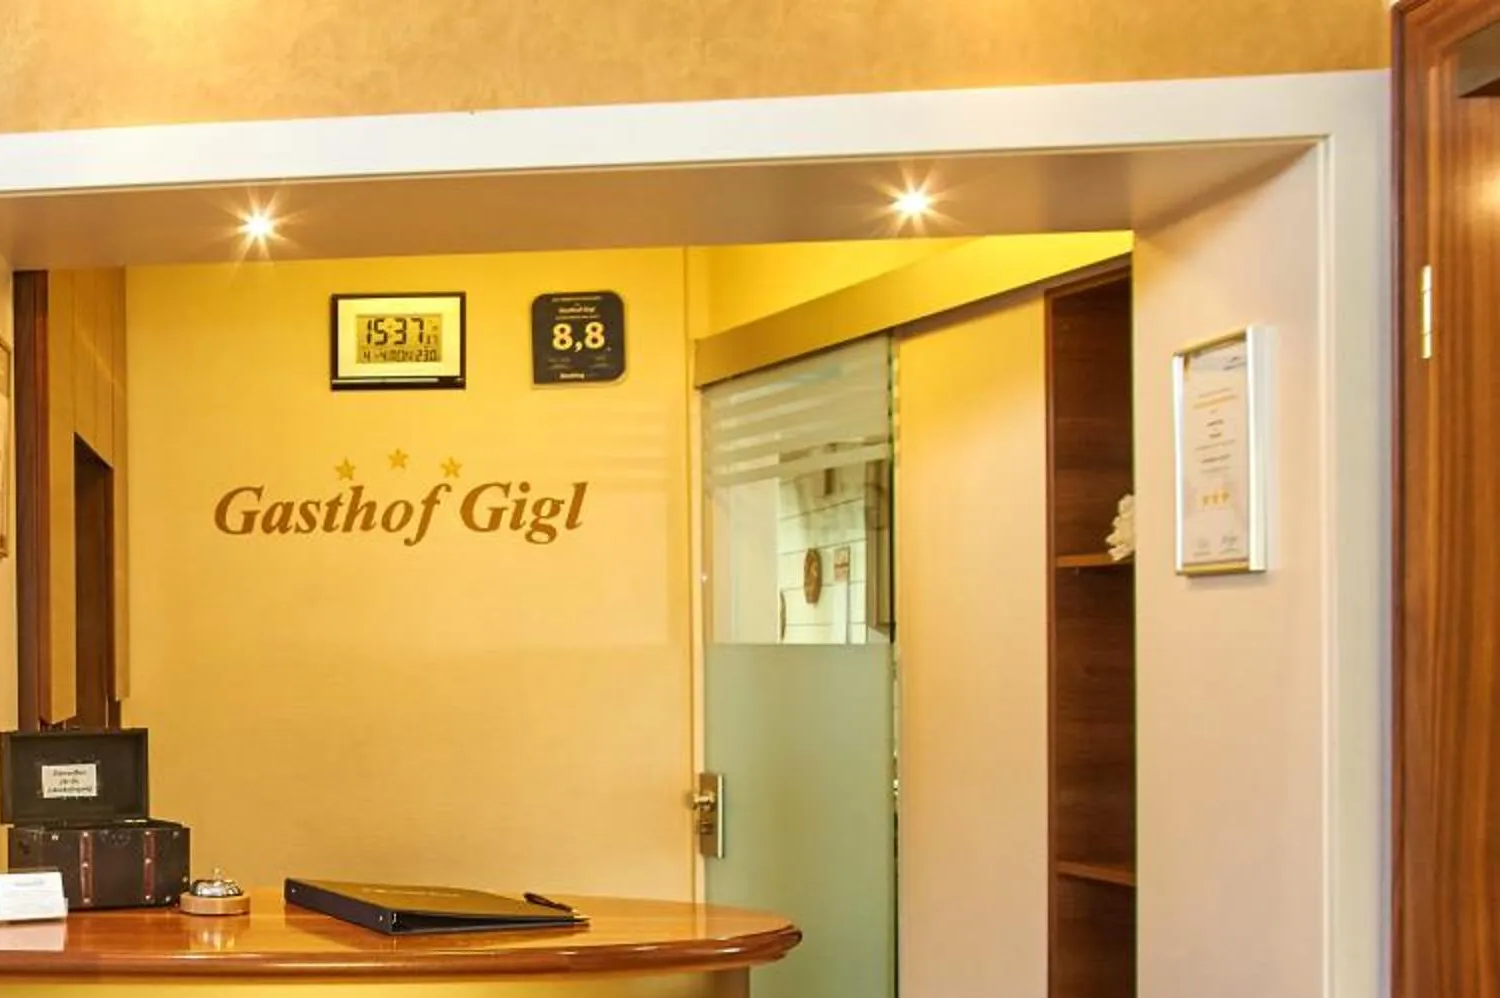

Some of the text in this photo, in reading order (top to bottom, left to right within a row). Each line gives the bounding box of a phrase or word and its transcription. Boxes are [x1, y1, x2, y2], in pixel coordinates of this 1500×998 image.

[552, 321, 606, 352] 8,8
[214, 481, 589, 546] Gasthof Gigl
